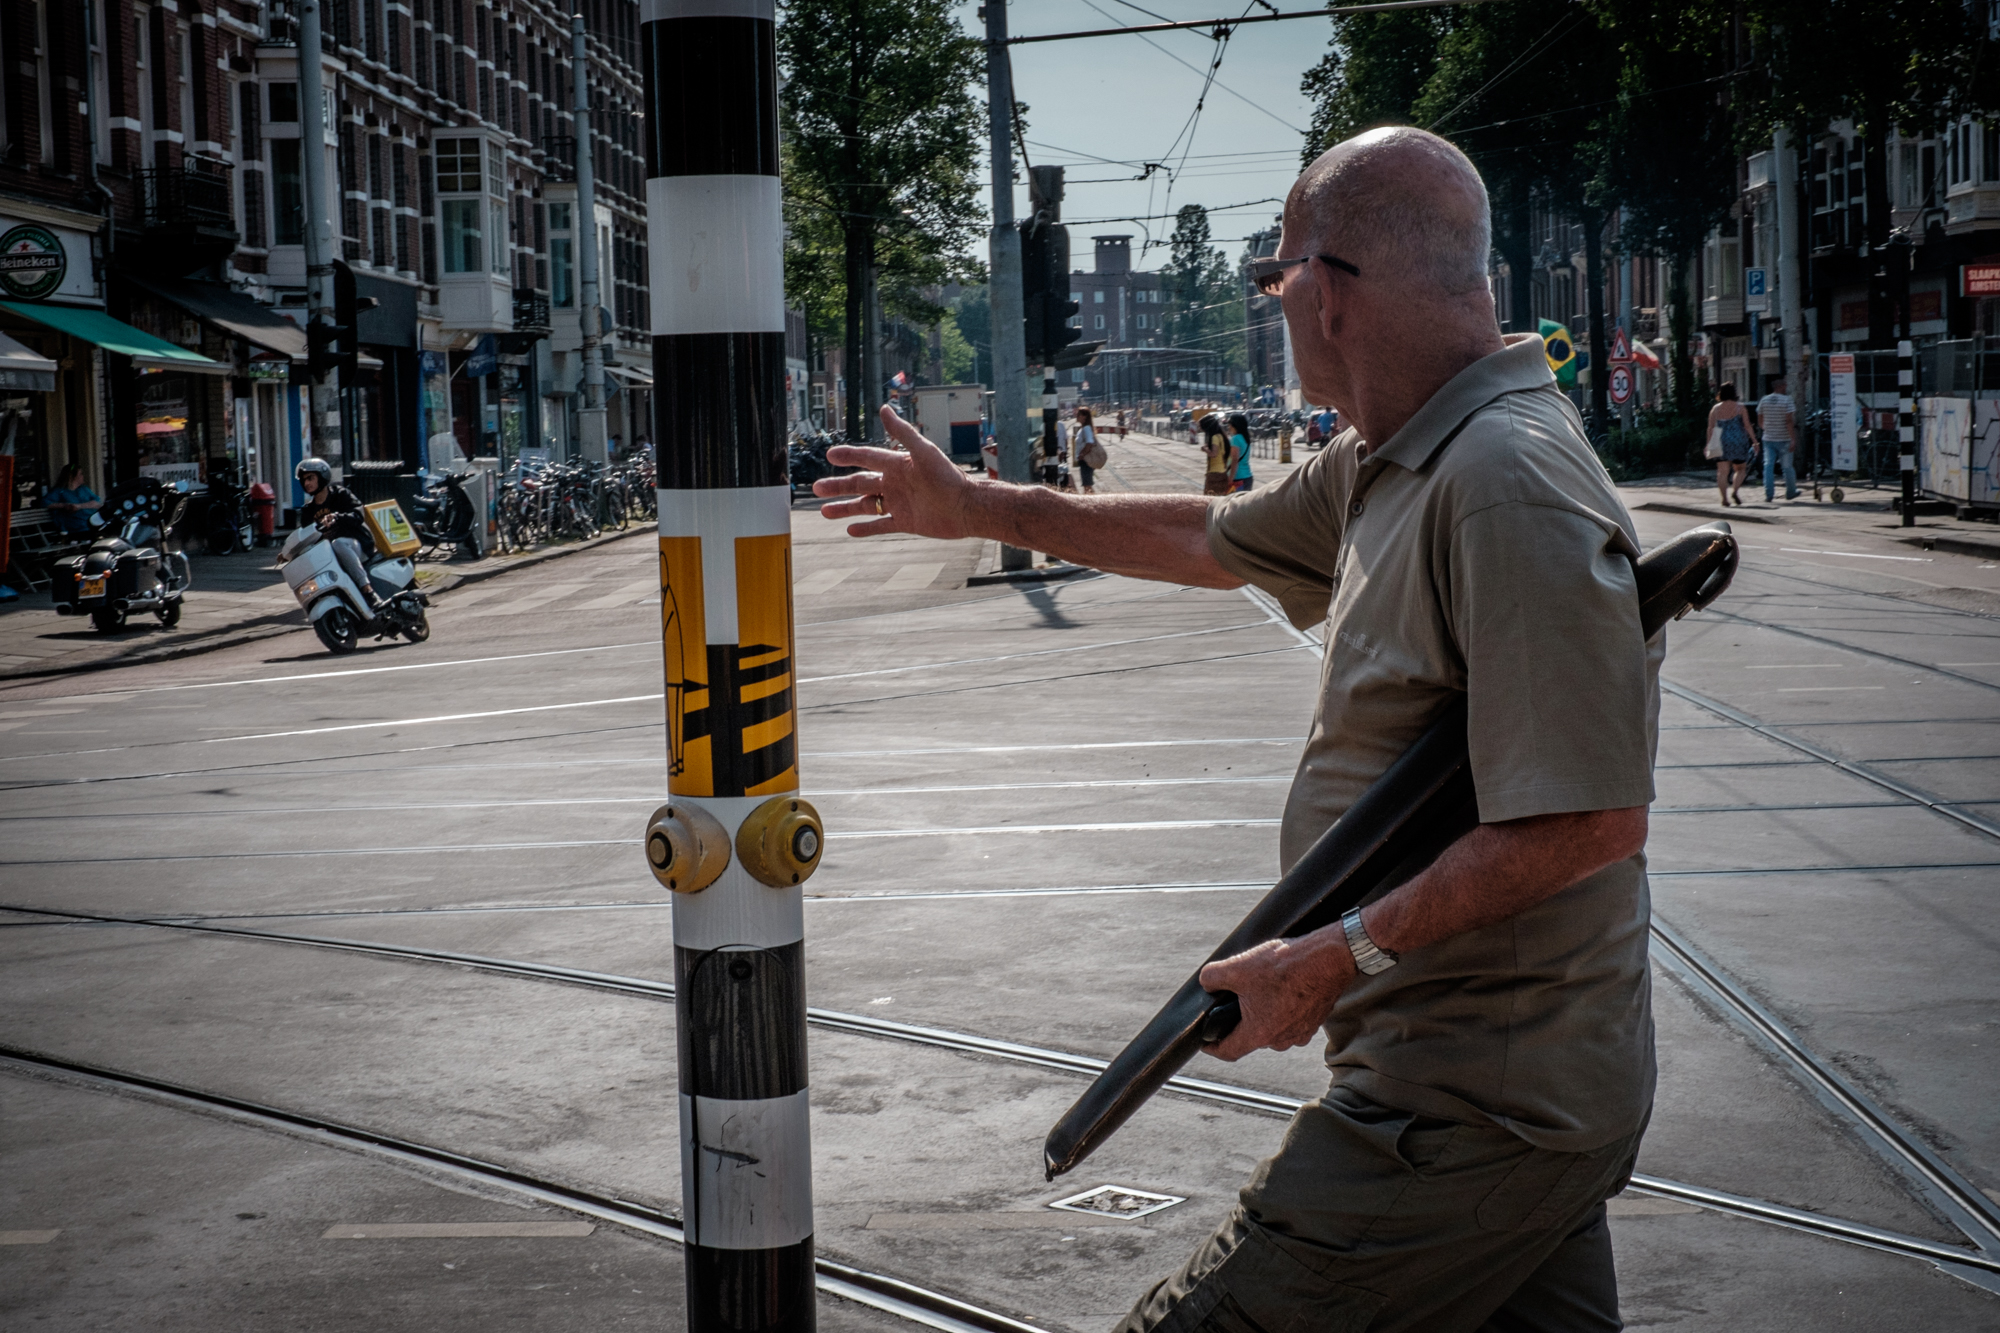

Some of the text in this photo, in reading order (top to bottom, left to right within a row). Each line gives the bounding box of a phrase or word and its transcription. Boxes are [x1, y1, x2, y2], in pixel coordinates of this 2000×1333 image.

[0, 256, 56, 269] Heineken
[1752, 273, 1761, 285] P
[1614, 377, 1628, 391] 30
